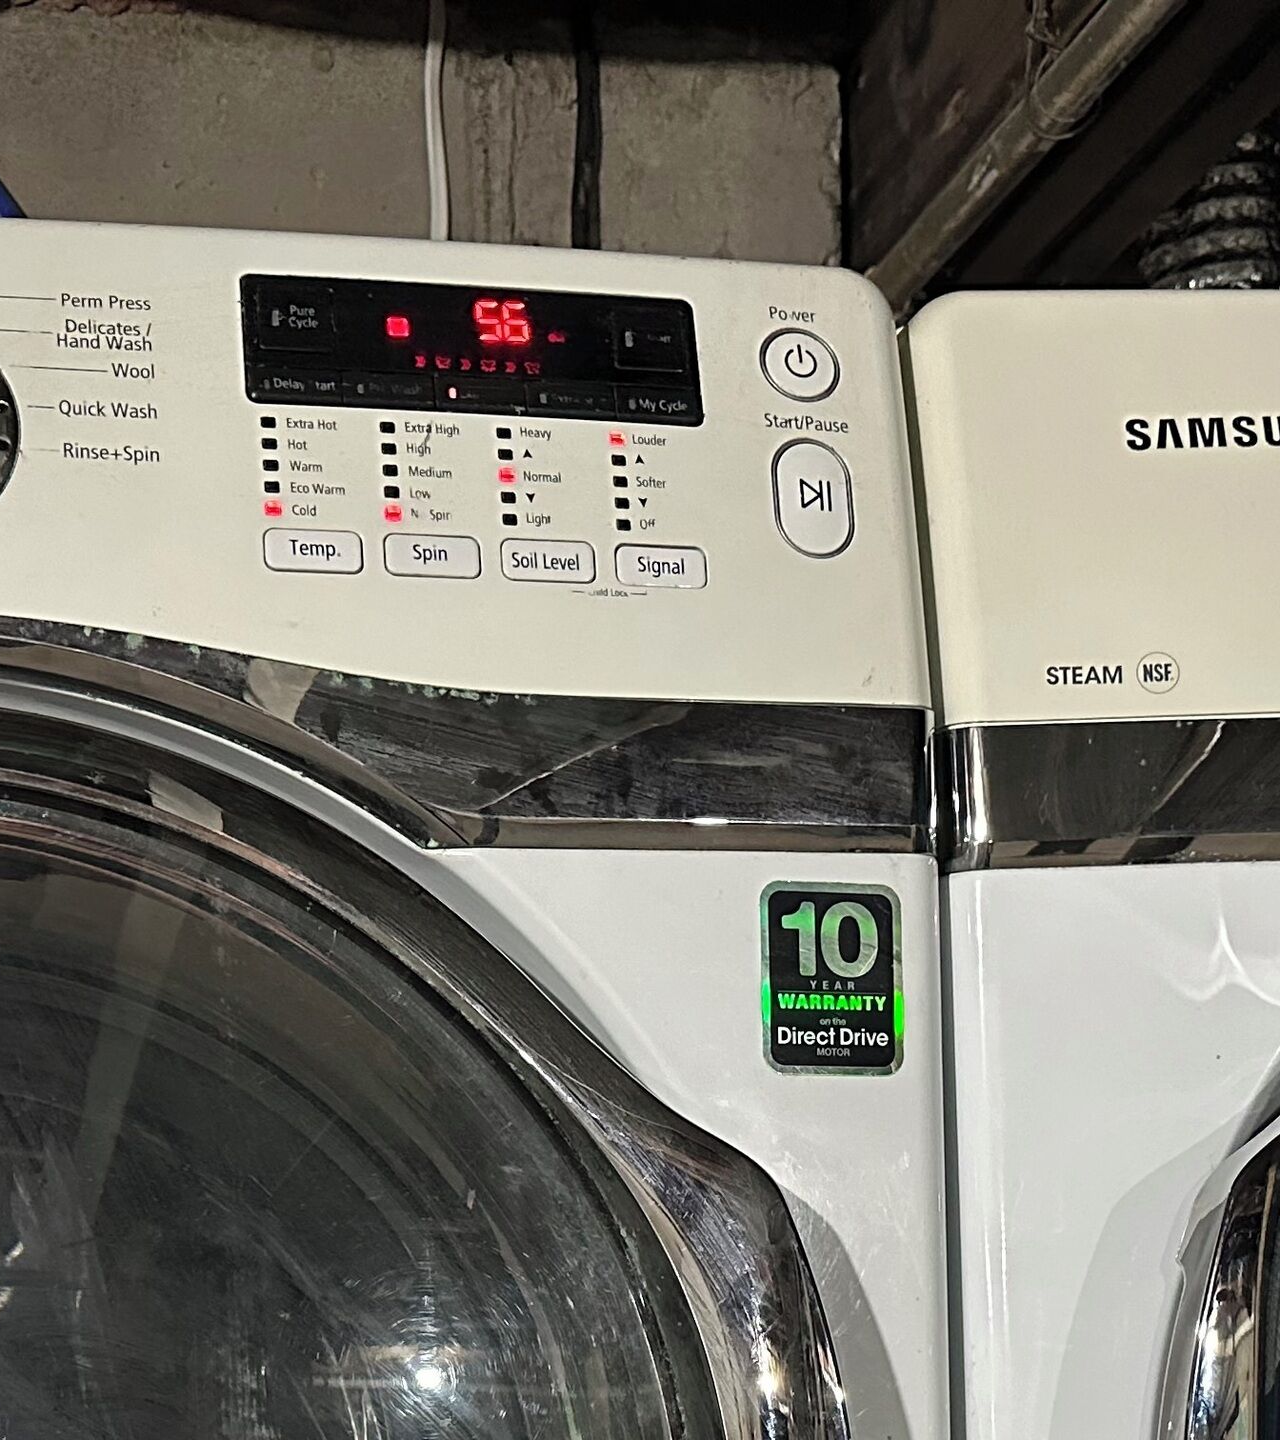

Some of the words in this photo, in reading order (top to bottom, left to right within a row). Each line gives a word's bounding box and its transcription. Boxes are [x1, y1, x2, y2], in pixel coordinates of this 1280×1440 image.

[61, 293, 102, 308] Perm
[109, 295, 151, 310] Press
[289, 304, 315, 316] Pure
[65, 318, 140, 336] Delicates
[288, 316, 318, 329] Cycle
[474, 300, 531, 342] 56
[57, 333, 100, 349] Hand
[106, 335, 152, 351] Wash
[111, 363, 155, 379] Wool
[273, 377, 305, 391] Delay
[311, 380, 336, 391] tart
[59, 400, 106, 417] Quick
[111, 402, 157, 419] Wash
[638, 398, 656, 411] My
[659, 400, 687, 413] Cycle
[286, 417, 314, 430] Extra
[317, 419, 337, 430] Hot
[405, 422, 432, 434] Extra
[435, 423, 460, 437] High
[764, 413, 849, 434] Start/Pause
[520, 427, 552, 441] Heavy
[632, 434, 666, 446] Louder
[288, 439, 307, 450] Hot
[406, 443, 431, 457] High
[63, 442, 160, 465] Rinse+Spin
[290, 461, 323, 472] Warm
[408, 466, 452, 479] Medium
[523, 471, 561, 483] Normal
[636, 476, 666, 488] Softer
[290, 482, 309, 494] Eco
[312, 483, 345, 496] Warm
[409, 489, 431, 500] Low
[292, 504, 316, 516] Cold
[526, 513, 551, 527] Light
[639, 518, 656, 530] Off
[289, 539, 341, 561] Temp.
[413, 544, 448, 564] Spin
[512, 552, 538, 569] Soil
[543, 553, 580, 571] Level
[637, 556, 685, 577] Signal
[1046, 666, 1123, 685] STEAM
[781, 901, 878, 978] 10
[809, 980, 855, 990] YEAR
[777, 993, 887, 1011] WARRANTY
[819, 1018, 832, 1026] on
[832, 1017, 847, 1026] the
[777, 1026, 836, 1045] Direct
[840, 1028, 889, 1046] Drive
[816, 1047, 851, 1057] MOTOR
